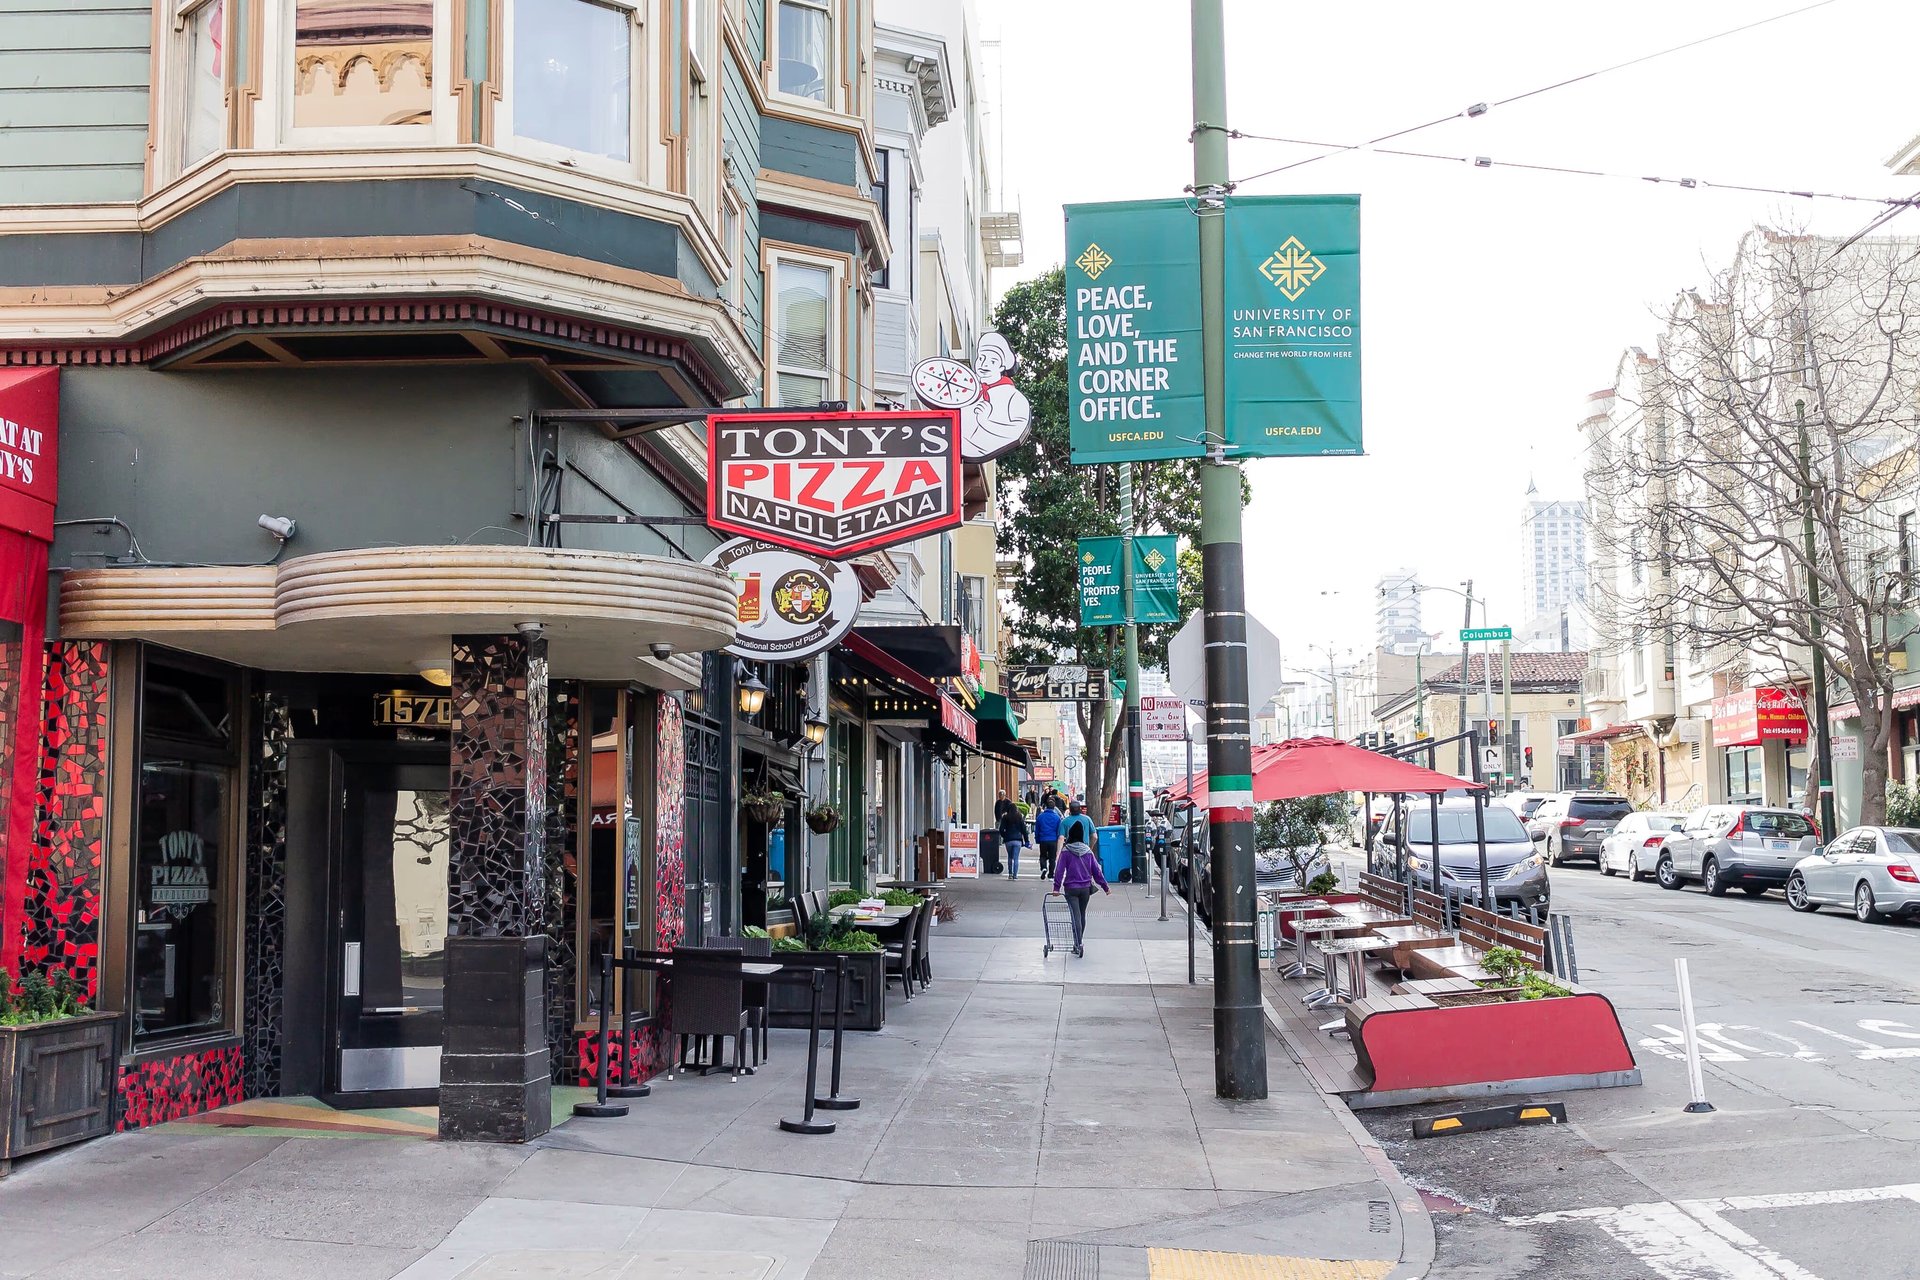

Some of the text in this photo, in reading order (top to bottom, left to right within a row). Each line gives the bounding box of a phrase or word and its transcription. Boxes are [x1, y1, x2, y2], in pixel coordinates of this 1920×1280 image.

[1076, 285, 1153, 311] PEACE,
[1233, 308, 1352, 321] UNIVERSITY OF
[1077, 313, 1141, 339] LOVE,
[1233, 325, 1352, 338] SAN FRANCISCO
[1078, 338, 1178, 367] AND THE
[1233, 351, 1264, 359] CHANGE
[1078, 367, 1170, 394] CORNER
[1079, 395, 1161, 422] OFFICE.
[1108, 431, 1164, 442] USFCA.EDU
[1265, 426, 1322, 436] USFCA.EDU
[19, 427, 43, 456] AT
[721, 425, 950, 458] TONY'S
[727, 460, 942, 513] PIZZA
[730, 492, 937, 540] NAPOLETANA
[728, 542, 754, 559] Tony
[1082, 565, 1112, 576] PEOPLE
[1082, 576, 1095, 586] OR
[1083, 585, 1120, 596] PROFITS?
[1083, 597, 1101, 607] YES.
[769, 641, 794, 651] School
[795, 638, 803, 647] of
[803, 630, 823, 645] Pizza
[1462, 629, 1510, 639] Columbus
[1011, 671, 1048, 692] Tony
[1047, 683, 1100, 698] CAFE
[379, 697, 452, 724] 1570
[1142, 698, 1154, 710] NO
[1155, 700, 1183, 709] PARKING
[1772, 699, 1787, 708] Hair
[1145, 723, 1181, 731] TUES THURS
[158, 830, 205, 864] TONY'S
[151, 866, 209, 885] PIZZA
